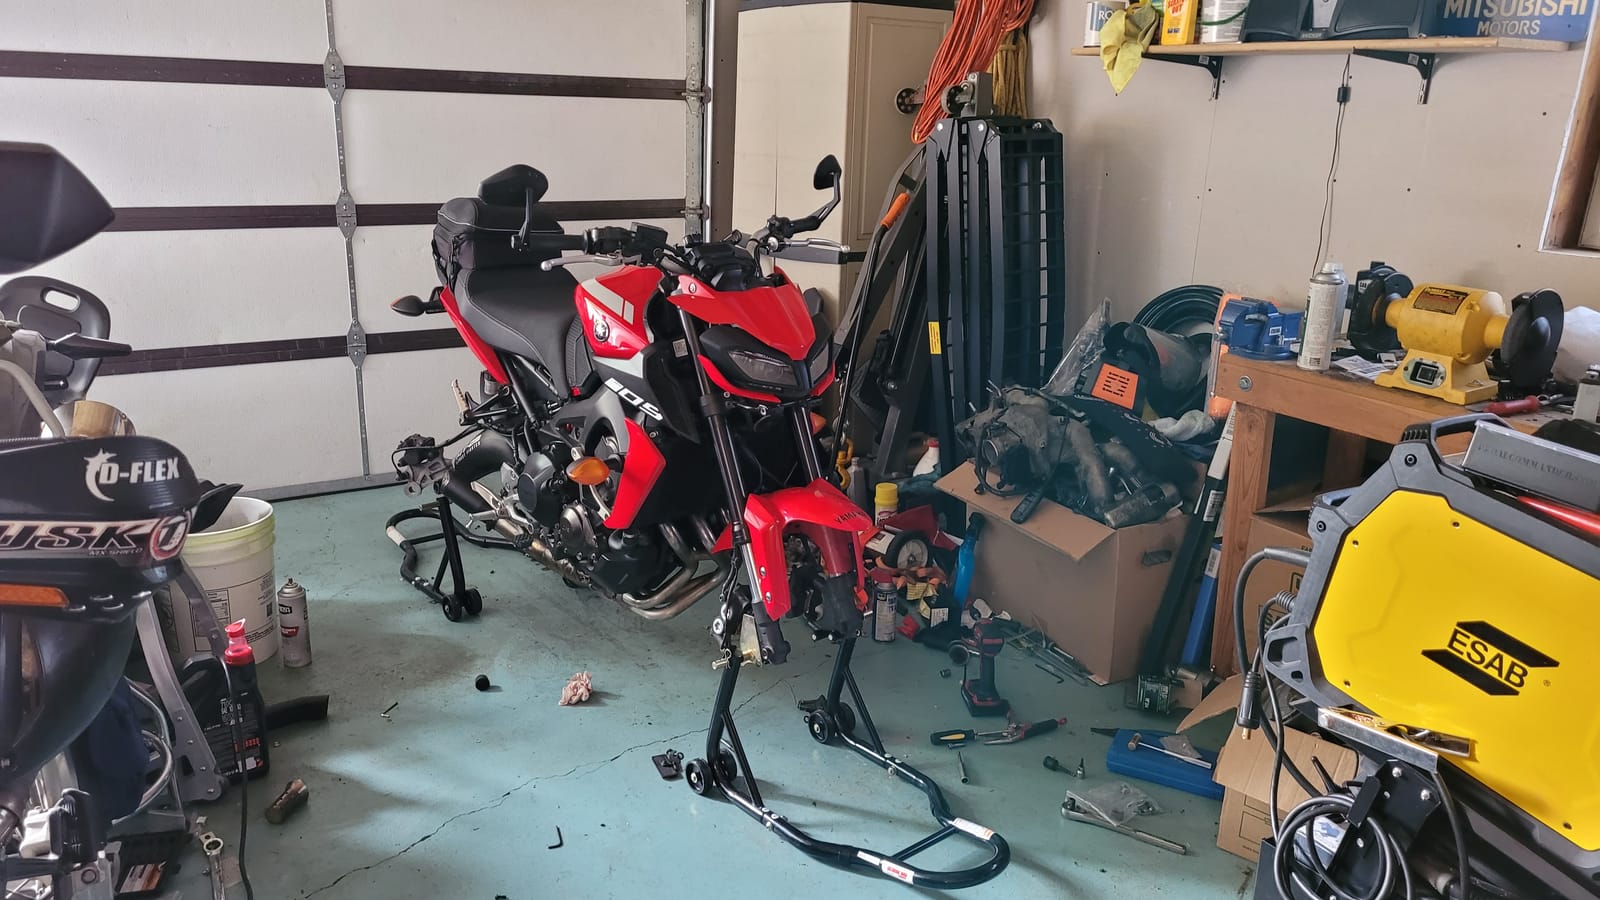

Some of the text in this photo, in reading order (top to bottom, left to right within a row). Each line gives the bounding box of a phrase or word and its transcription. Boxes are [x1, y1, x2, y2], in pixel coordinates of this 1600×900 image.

[1099, 9, 1113, 21] RO
[1477, 19, 1541, 35] MOTORS
[100, 457, 180, 484] D-FLEX
[0, 523, 142, 550] USK
[1447, 628, 1528, 688] ESAB
